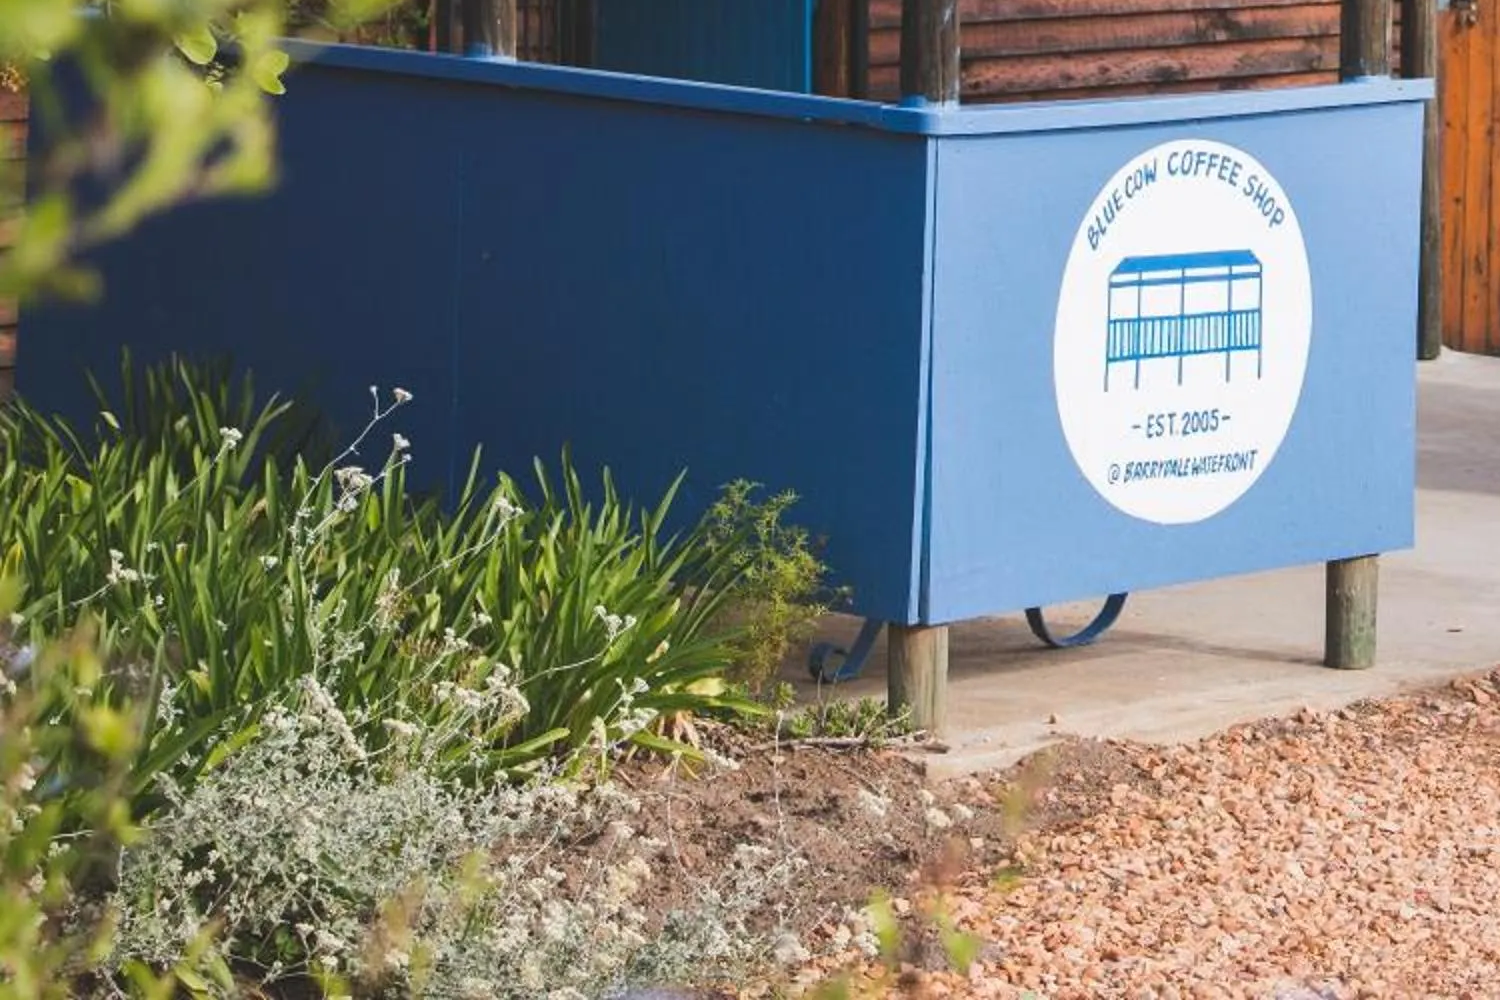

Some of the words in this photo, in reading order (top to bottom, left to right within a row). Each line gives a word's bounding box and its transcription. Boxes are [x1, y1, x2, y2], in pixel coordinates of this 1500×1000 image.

[1087, 188, 1126, 251] BLUE
[1124, 157, 1158, 199] COW
[1167, 149, 1243, 188] COFFEE
[1242, 174, 1286, 229] SHOP
